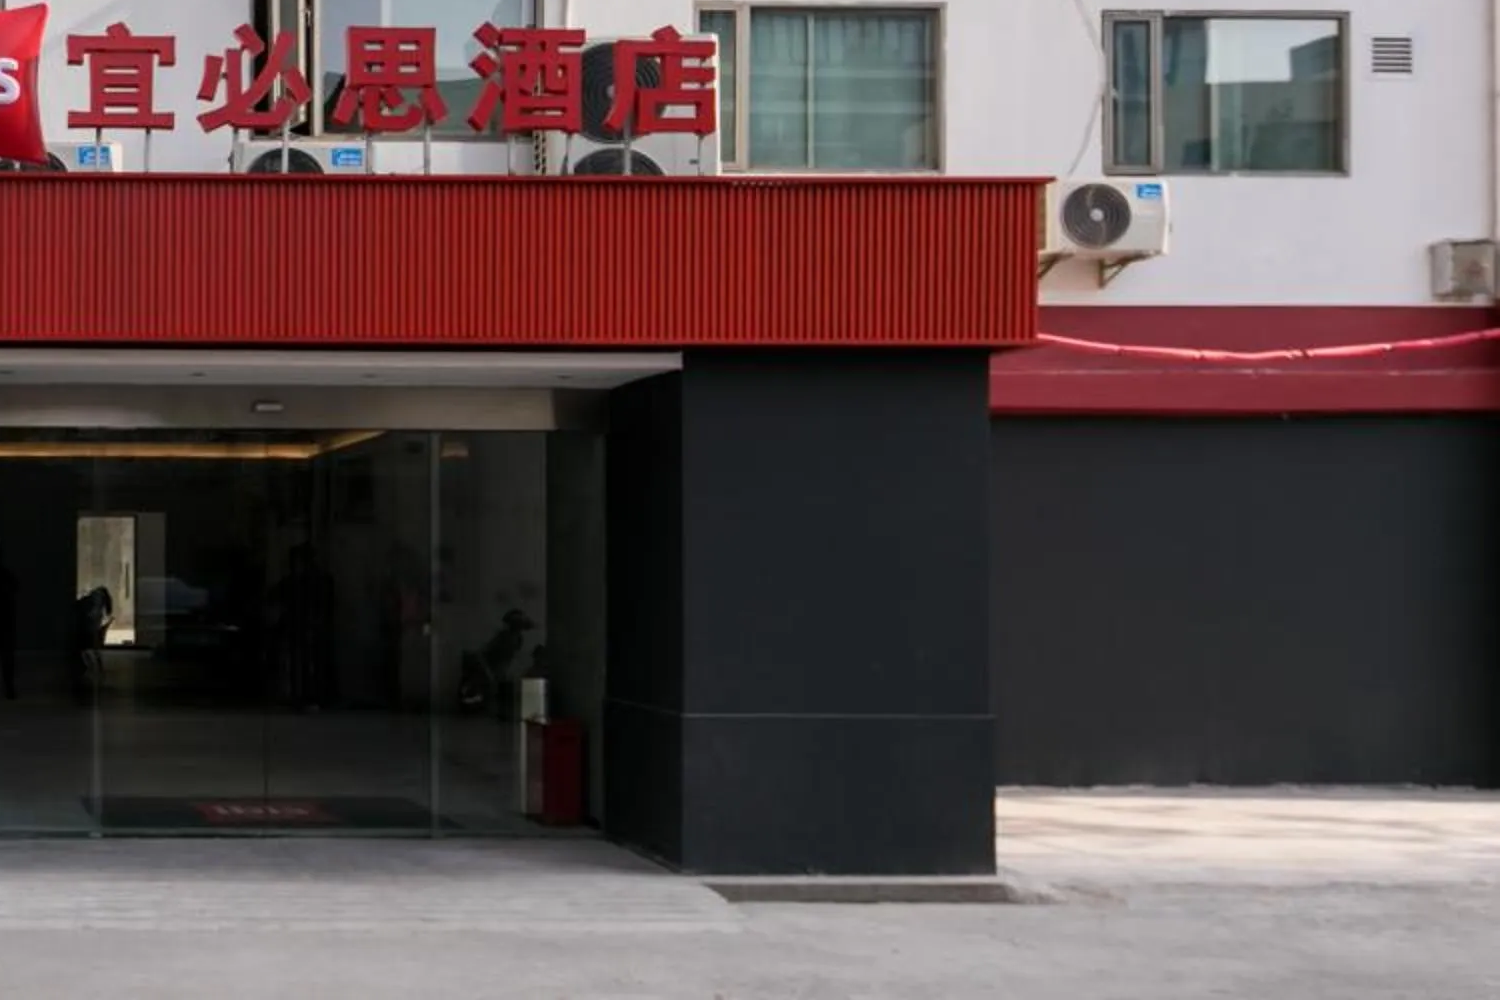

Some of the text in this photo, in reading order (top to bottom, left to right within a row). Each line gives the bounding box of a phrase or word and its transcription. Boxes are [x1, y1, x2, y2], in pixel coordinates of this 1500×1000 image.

[66, 21, 717, 134] 宜必思酒店
